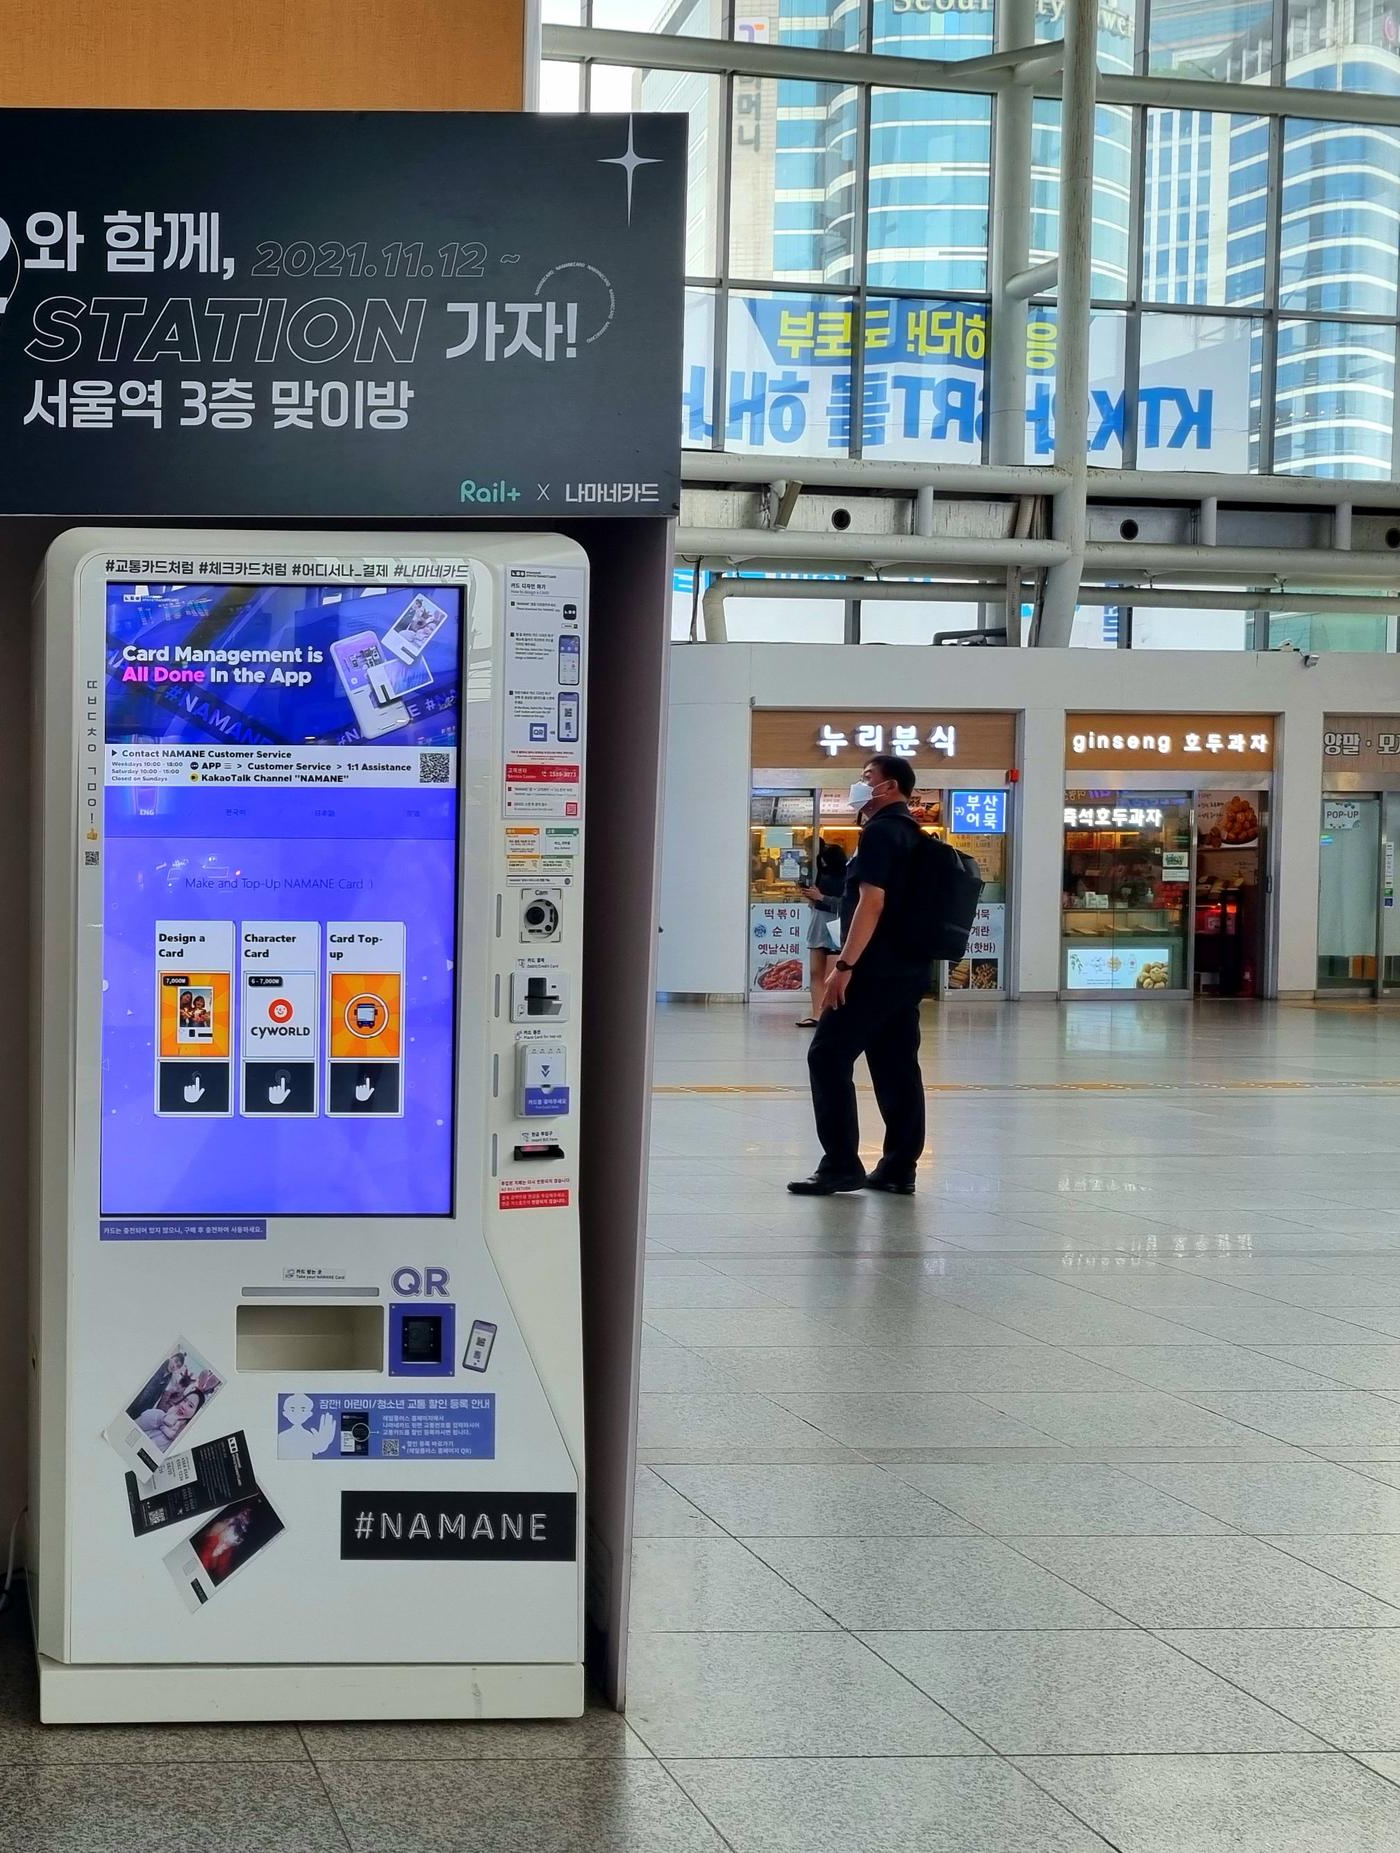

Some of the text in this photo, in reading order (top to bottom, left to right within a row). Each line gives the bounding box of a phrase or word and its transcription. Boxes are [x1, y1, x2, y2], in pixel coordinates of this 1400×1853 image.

[103, 210, 237, 281] 함께,
[252, 241, 488, 278] 2021.11.12
[24, 296, 427, 363] STATION
[446, 301, 578, 361] 가자!
[23, 379, 414, 430] 서울역 3층 맞이방
[460, 480, 522, 504] Rail+
[565, 483, 660, 503] 나마네카드
[105, 559, 469, 578] #교통카드처럼 #체크카드처럼 #어디서나_결제 #나마네카드
[122, 645, 323, 665] Card Management is
[122, 666, 312, 687] All Done In the App
[819, 723, 956, 758] 누리분식
[1072, 731, 1269, 753] ginseng 호두과자
[1323, 732, 1360, 756] 양말
[121, 749, 292, 759] Contact NAMANE Customer Service
[201, 762, 412, 772] APP Customer Service 1:1 Assistance
[201, 774, 293, 783] KakaoTalk Channel
[966, 794, 999, 812] 부산
[966, 813, 998, 830] 어묵
[1326, 810, 1359, 819] POP-UP
[185, 878, 364, 892] Make and Top-Up NAMANE Card
[764, 908, 800, 920] 떡볶이
[158, 933, 205, 944] Design a
[244, 933, 297, 943] Character
[329, 934, 383, 946] Card Top-
[772, 926, 800, 938] 순대
[158, 948, 184, 958] Card
[244, 949, 269, 958] Card
[329, 951, 344, 960] up
[390, 1266, 450, 1298] QR
[319, 1399, 490, 1409] 잠깐! 어린이/청소년 교통 할인 등록 안내
[354, 1511, 548, 1541] #NAMANE
